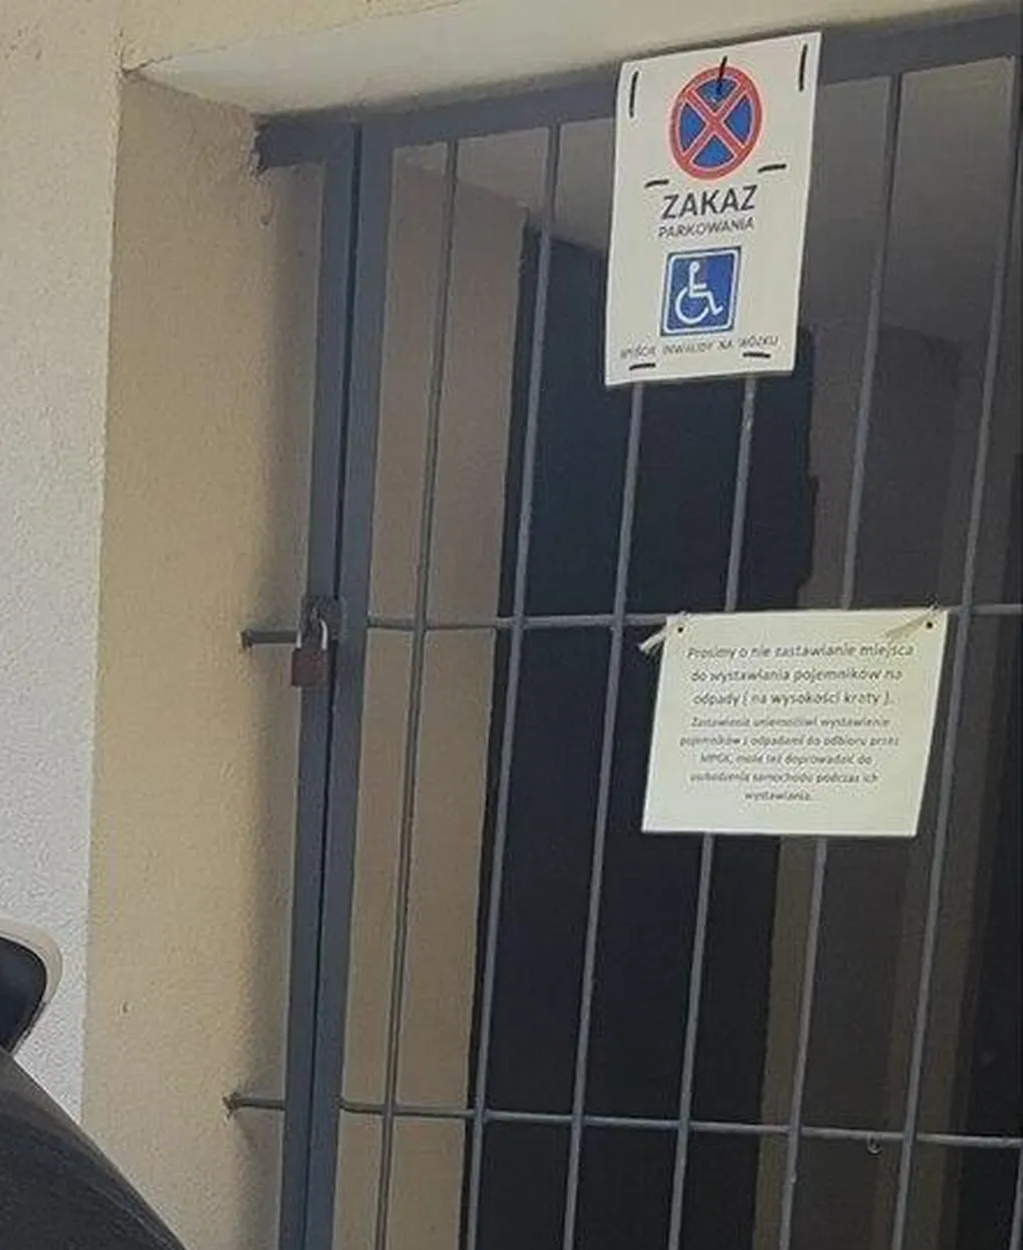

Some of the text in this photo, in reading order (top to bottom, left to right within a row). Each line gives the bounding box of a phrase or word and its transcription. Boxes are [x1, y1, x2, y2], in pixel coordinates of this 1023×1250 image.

[662, 184, 757, 219] ZAKAZ
[658, 217, 754, 237] PARKOWANIA
[718, 337, 733, 350] NA
[686, 643, 914, 660] Prosimy o nie zastawianie miejsca
[690, 666, 903, 684] do wystawiania pojemników na
[693, 692, 741, 707] odpady
[751, 694, 767, 705] na
[770, 691, 840, 707] wysokości
[844, 691, 881, 705] kraty
